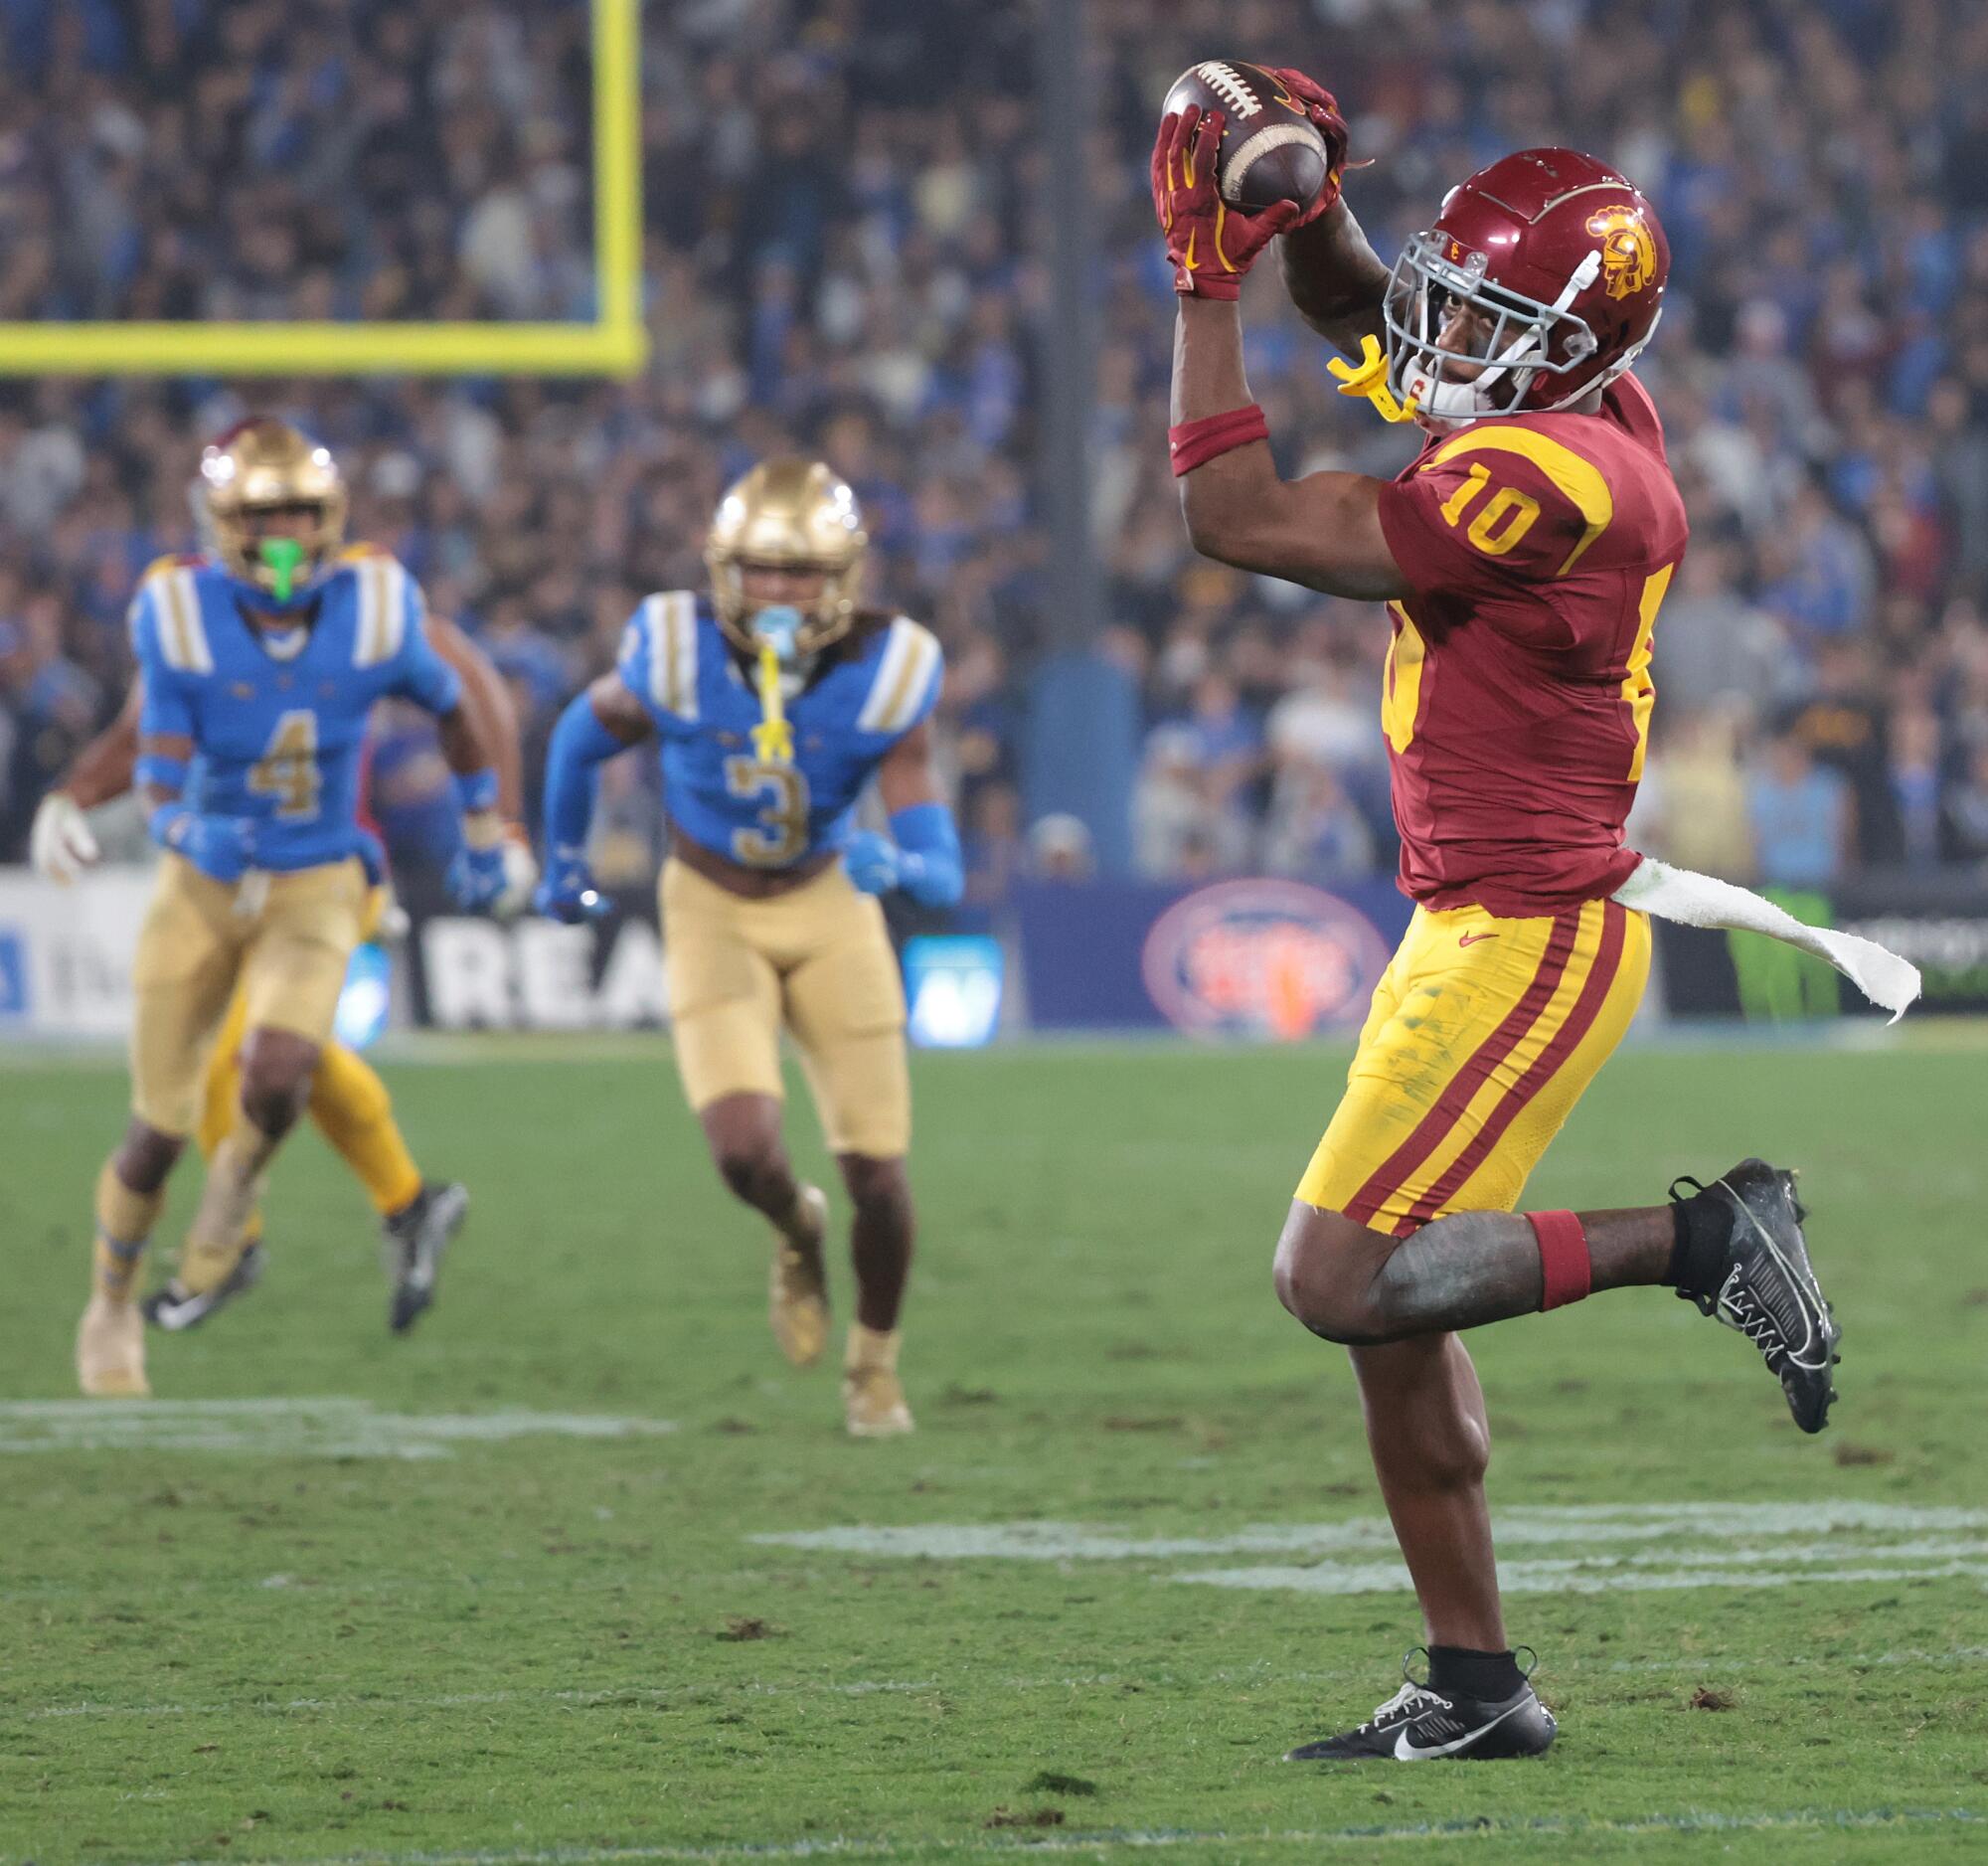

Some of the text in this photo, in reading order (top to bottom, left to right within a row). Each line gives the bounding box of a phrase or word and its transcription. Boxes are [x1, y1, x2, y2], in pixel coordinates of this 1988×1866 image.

[1440, 462, 1541, 555] 10
[247, 709, 319, 822] 4
[724, 755, 810, 869] 3
